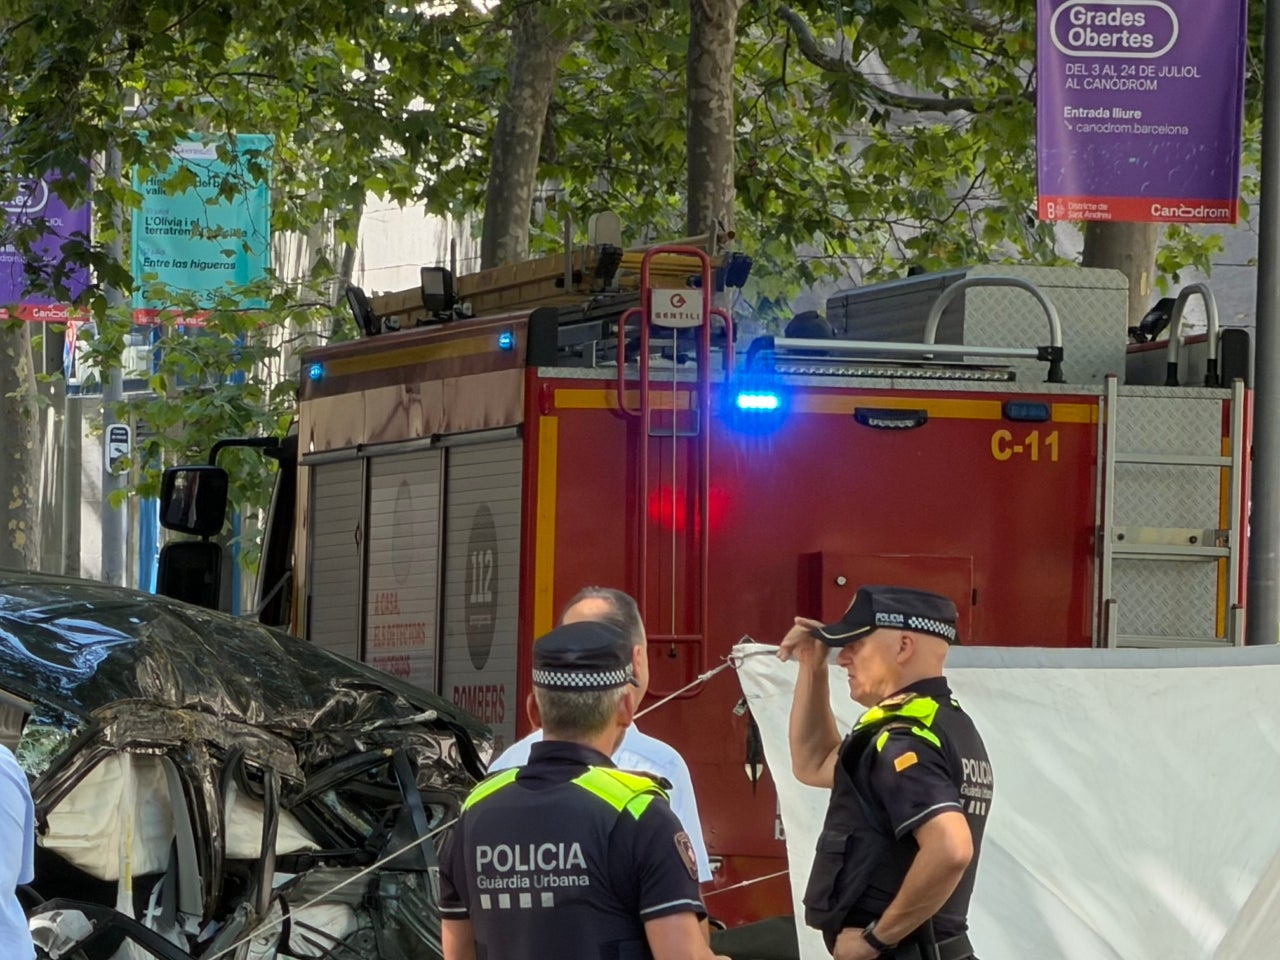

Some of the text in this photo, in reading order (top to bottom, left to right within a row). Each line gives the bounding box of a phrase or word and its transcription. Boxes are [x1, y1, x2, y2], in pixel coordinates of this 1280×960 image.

[1069, 6, 1146, 27] Grades
[1068, 27, 1155, 48] Obertes
[1065, 63, 1202, 78] DEL 3 AL 24 DE JULIOL
[1065, 78, 1081, 89] AL
[1063, 106, 1142, 119] Entrada lliure
[1075, 121, 1189, 135] canodrom.barcelona
[143, 257, 237, 271] Entre las higueras
[655, 311, 700, 320] GENTILI
[991, 429, 1059, 462] C-11
[470, 550, 493, 604] 112
[875, 612, 904, 623] POLICIA
[453, 683, 506, 725] BOMBERS
[476, 842, 588, 873] POLICIA
[476, 873, 590, 889] Guàrdia Urbana
